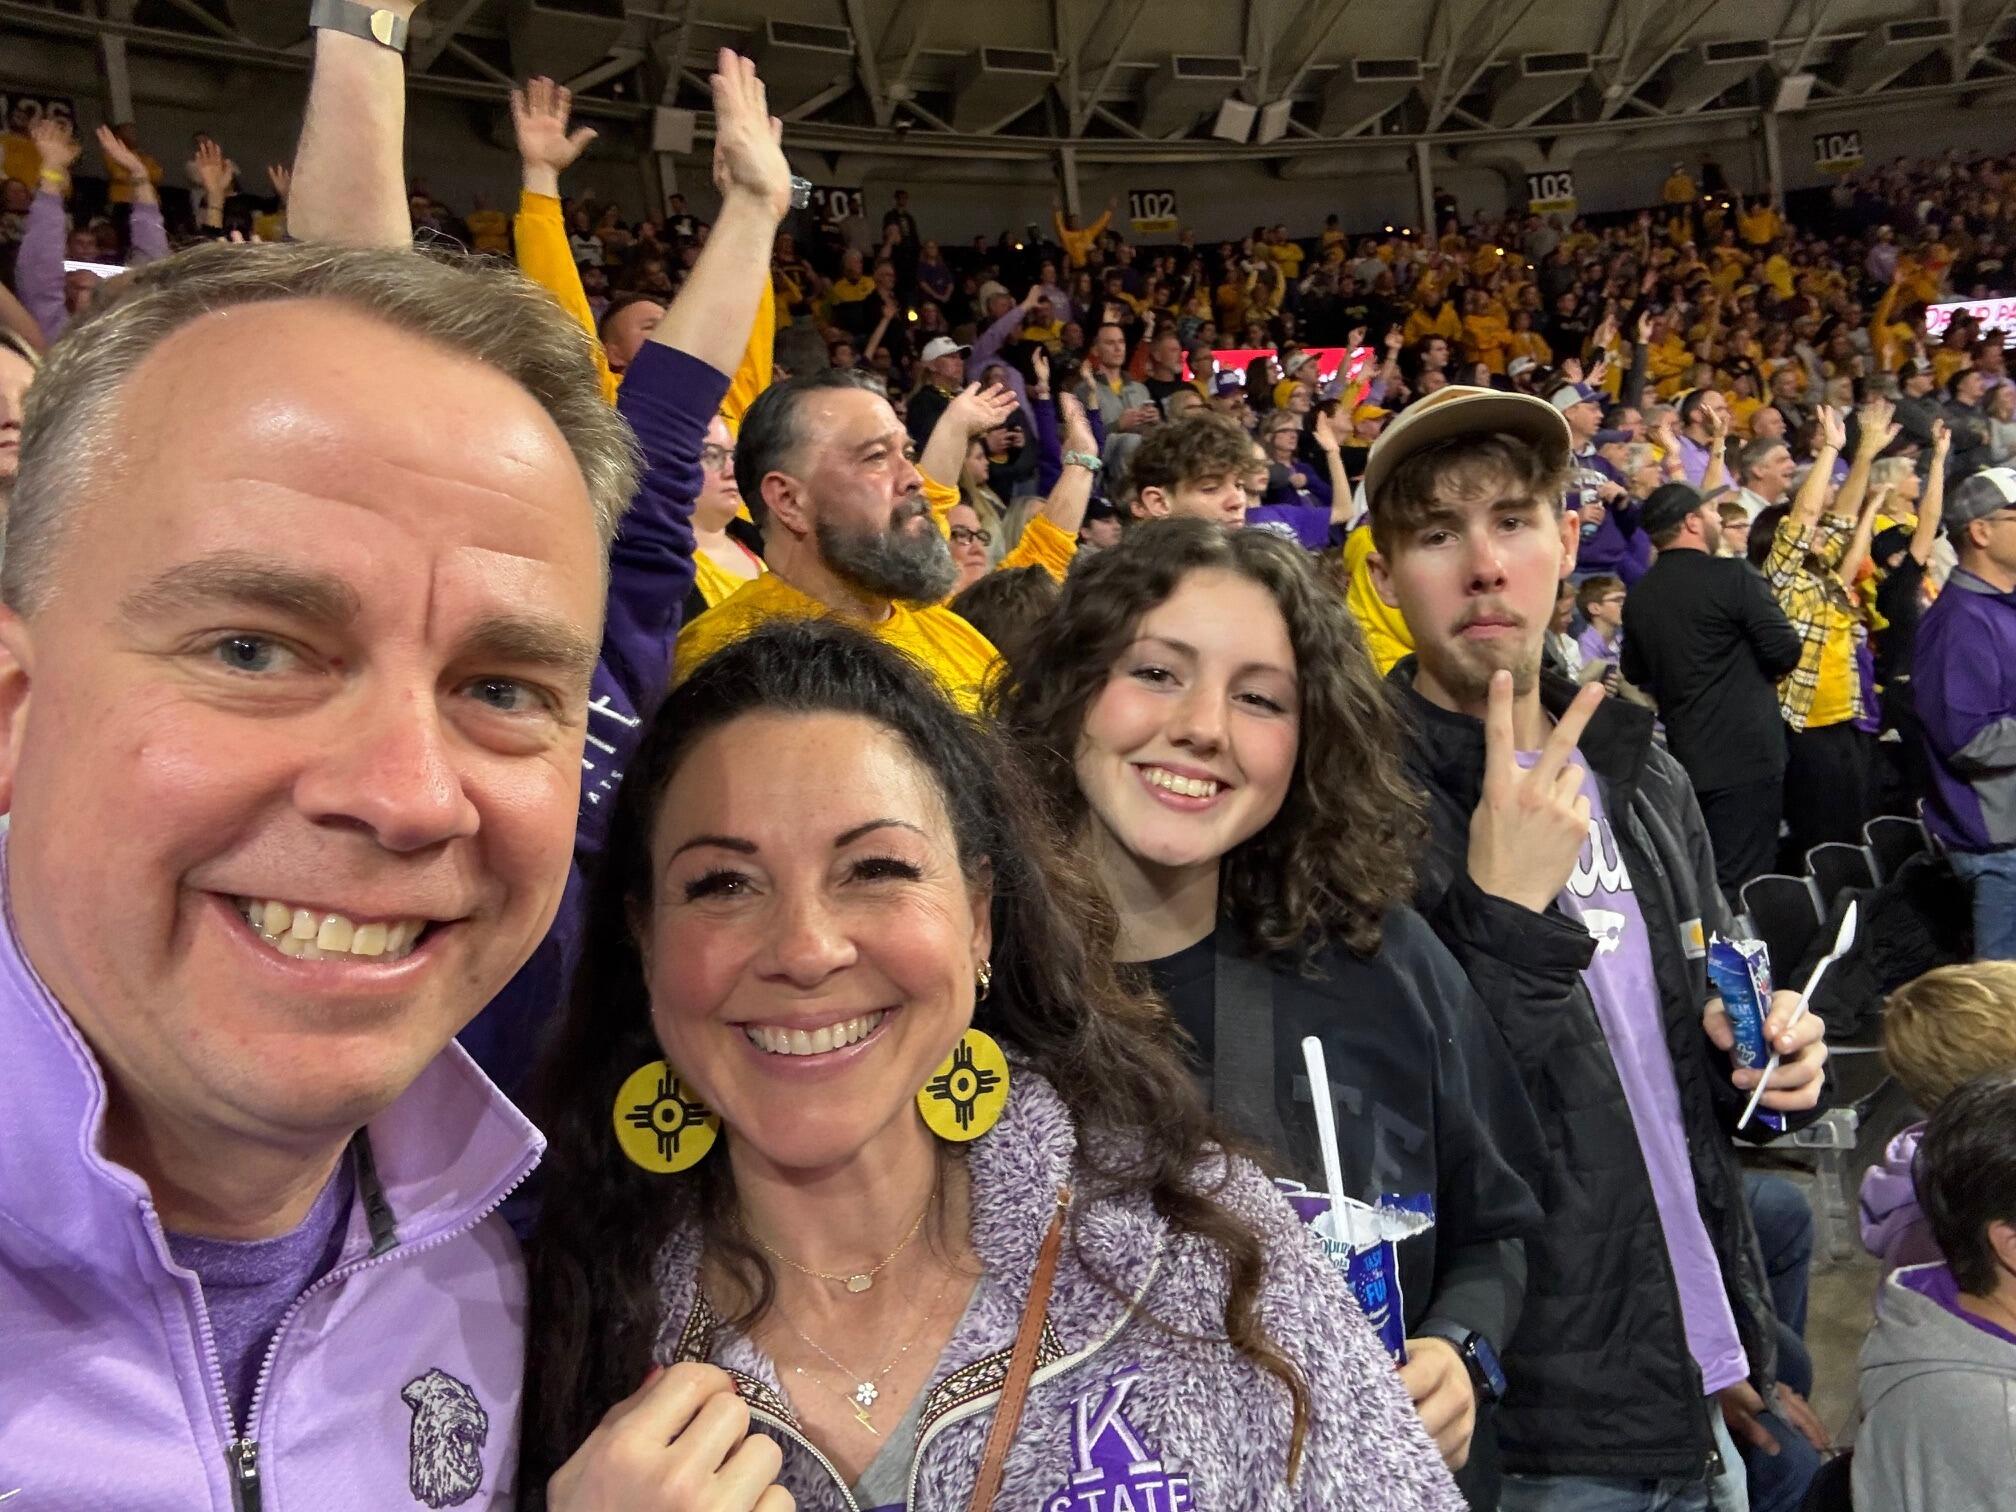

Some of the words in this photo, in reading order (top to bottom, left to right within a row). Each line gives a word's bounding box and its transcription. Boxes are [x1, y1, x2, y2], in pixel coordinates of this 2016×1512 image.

[1528, 173, 1574, 199] 103
[1130, 193, 1176, 219] 102
[1069, 1366, 1163, 1485] K
